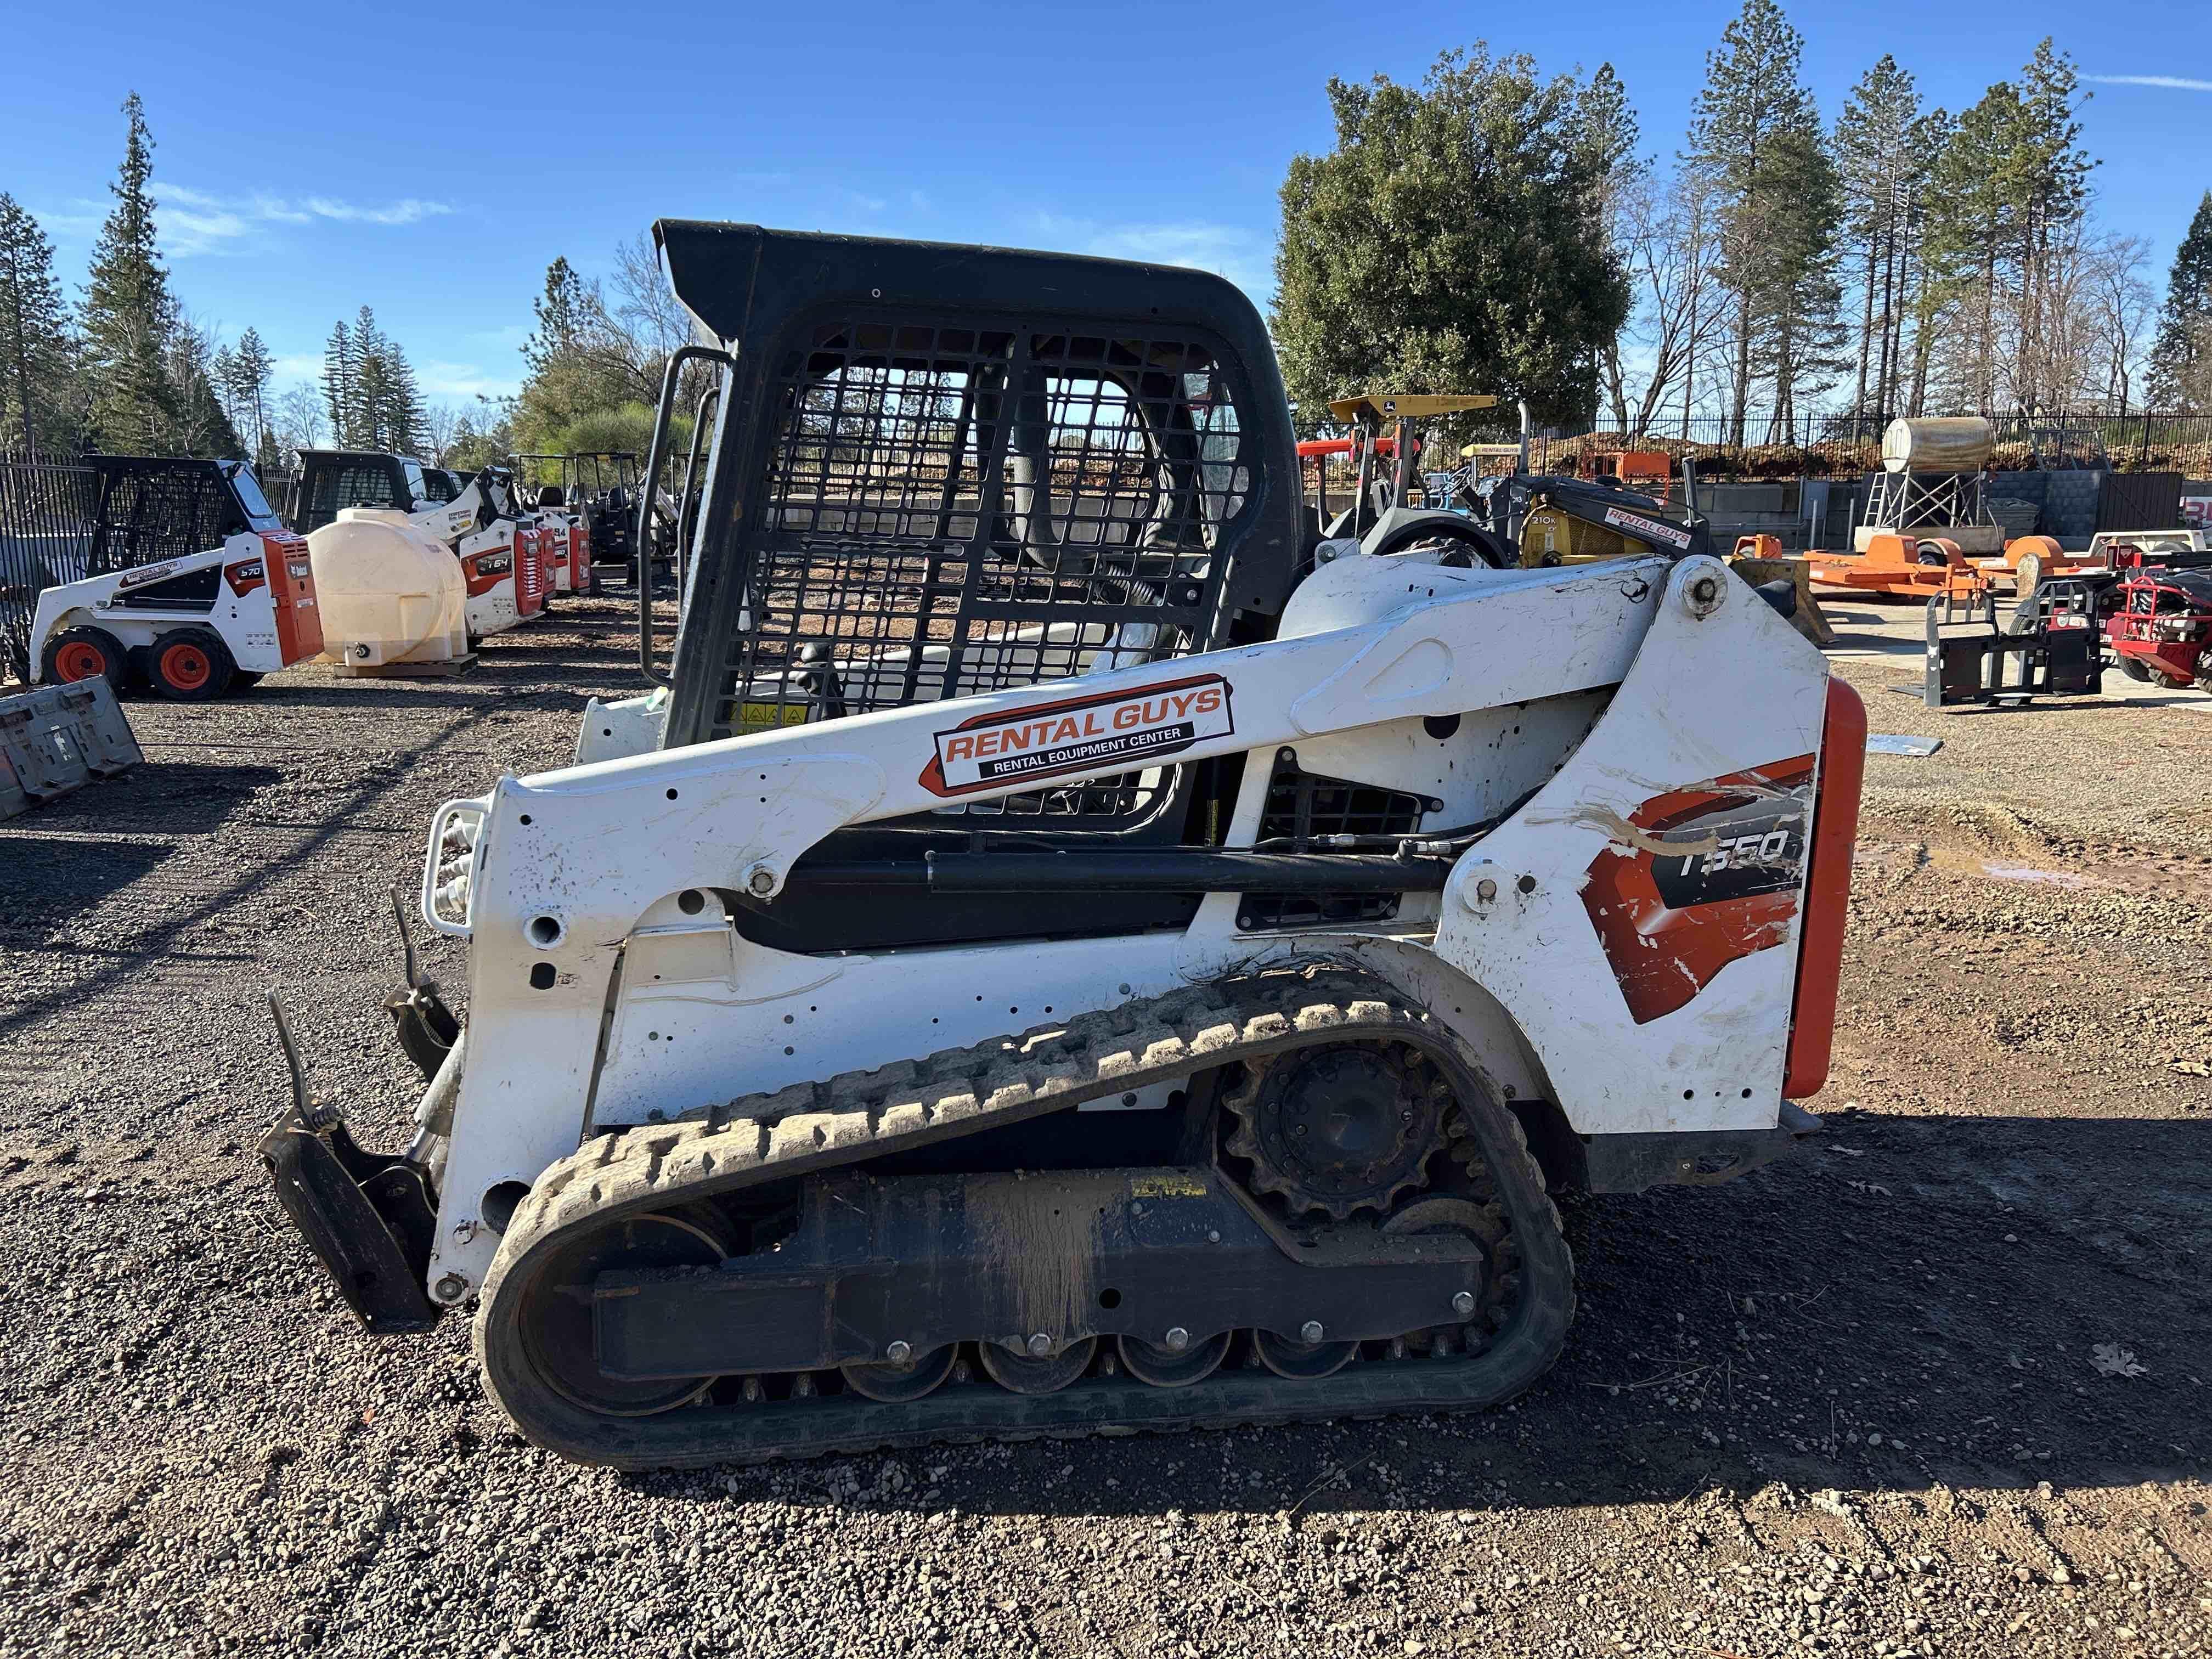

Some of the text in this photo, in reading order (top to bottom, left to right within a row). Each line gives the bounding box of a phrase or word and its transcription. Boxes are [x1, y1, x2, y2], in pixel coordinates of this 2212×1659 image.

[1609, 510, 1689, 542] RENTAL GUYS
[946, 689, 1221, 763] RENTAL GUYS
[994, 728, 1181, 773] RENTAL EQUIPMENT CENTER
